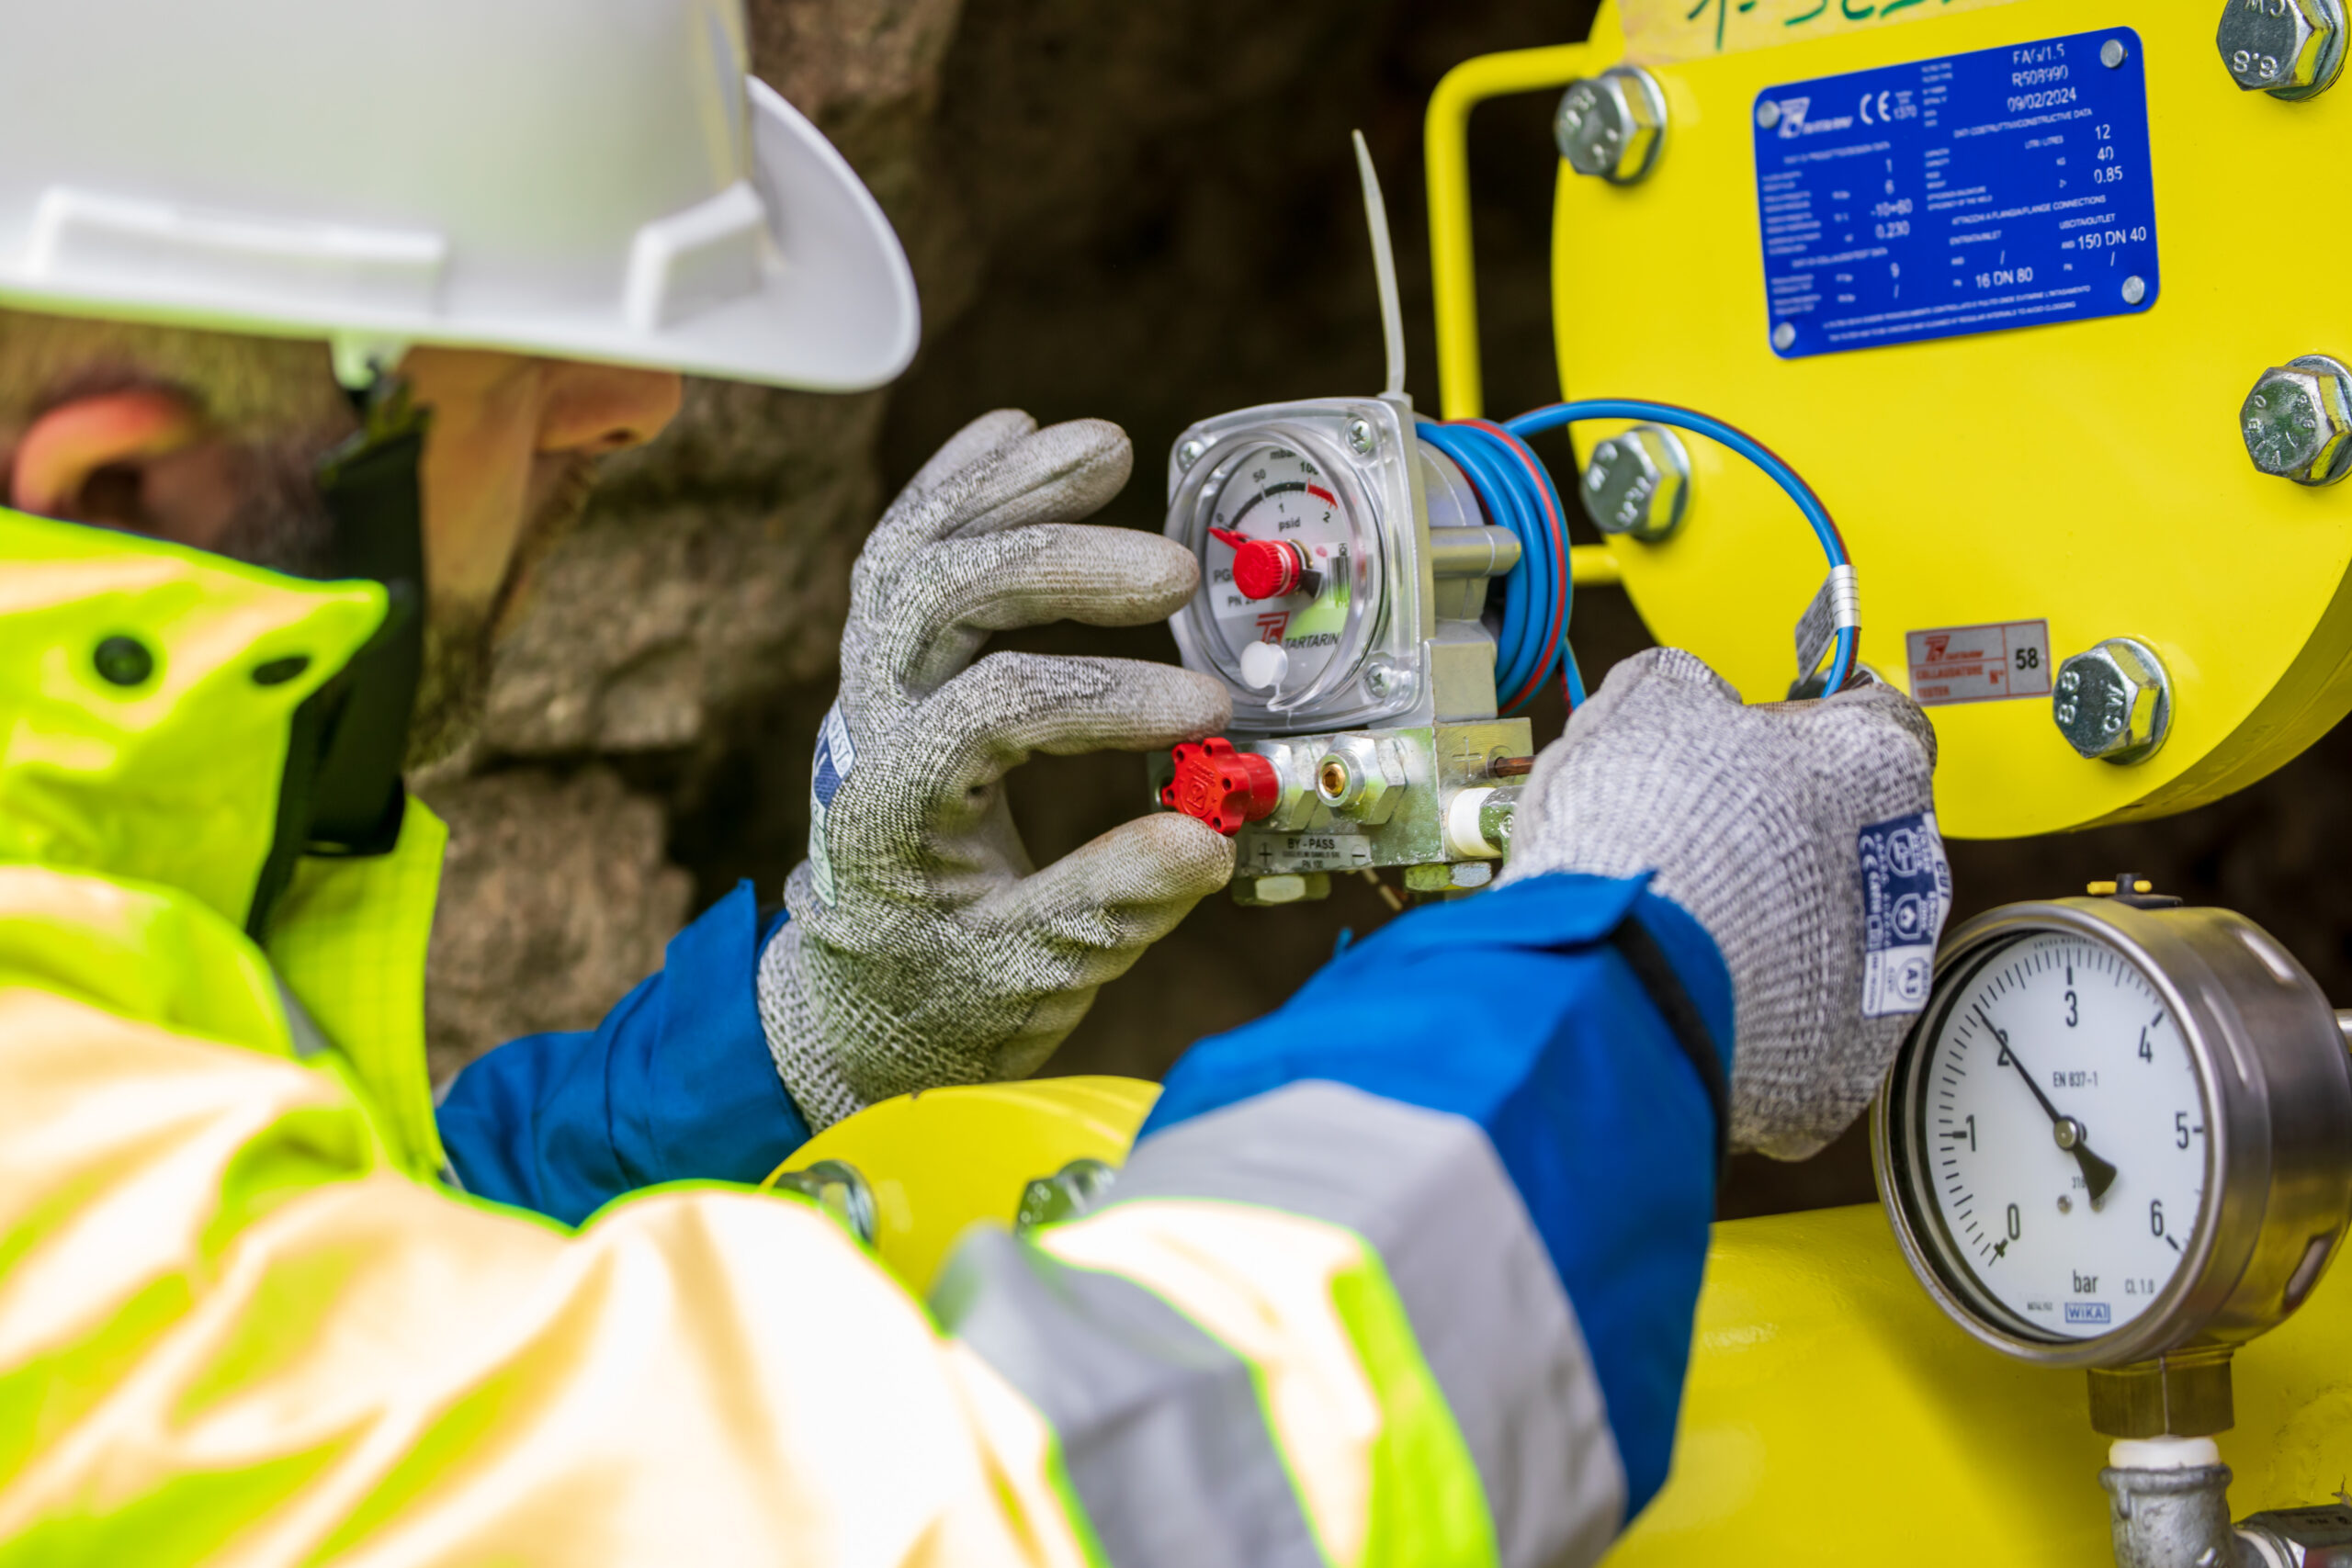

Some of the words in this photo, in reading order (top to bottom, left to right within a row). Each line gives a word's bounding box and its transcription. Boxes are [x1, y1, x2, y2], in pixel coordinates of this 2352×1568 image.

[2007, 86, 2076, 112] 09/02/2024
[2095, 124, 2111, 140] 12
[2097, 146, 2114, 161] 40
[2094, 165, 2123, 184] 0.85
[2078, 232, 2101, 250] 150
[2106, 230, 2127, 246] DN
[2130, 226, 2147, 243] 40
[1975, 273, 1991, 288] 16
[1994, 270, 2014, 287] DN
[2017, 266, 2033, 284] 80
[1253, 468, 1266, 482] 50
[1278, 517, 1301, 532] psid
[1323, 512, 1330, 524] 2
[2015, 647, 2040, 671] 58
[1308, 838, 1336, 850] PASS
[2064, 990, 2078, 1028] 3
[1996, 1029, 2010, 1066] 2
[2138, 1025, 2153, 1064] 4
[2052, 1071, 2065, 1088] EN
[2069, 1071, 2098, 1088] 837-1
[1965, 1114, 1976, 1152] 1
[2176, 1111, 2188, 1149] 5
[2007, 1202, 2020, 1241] 0
[2150, 1199, 2164, 1237] 6
[2073, 1269, 2098, 1293] bar
